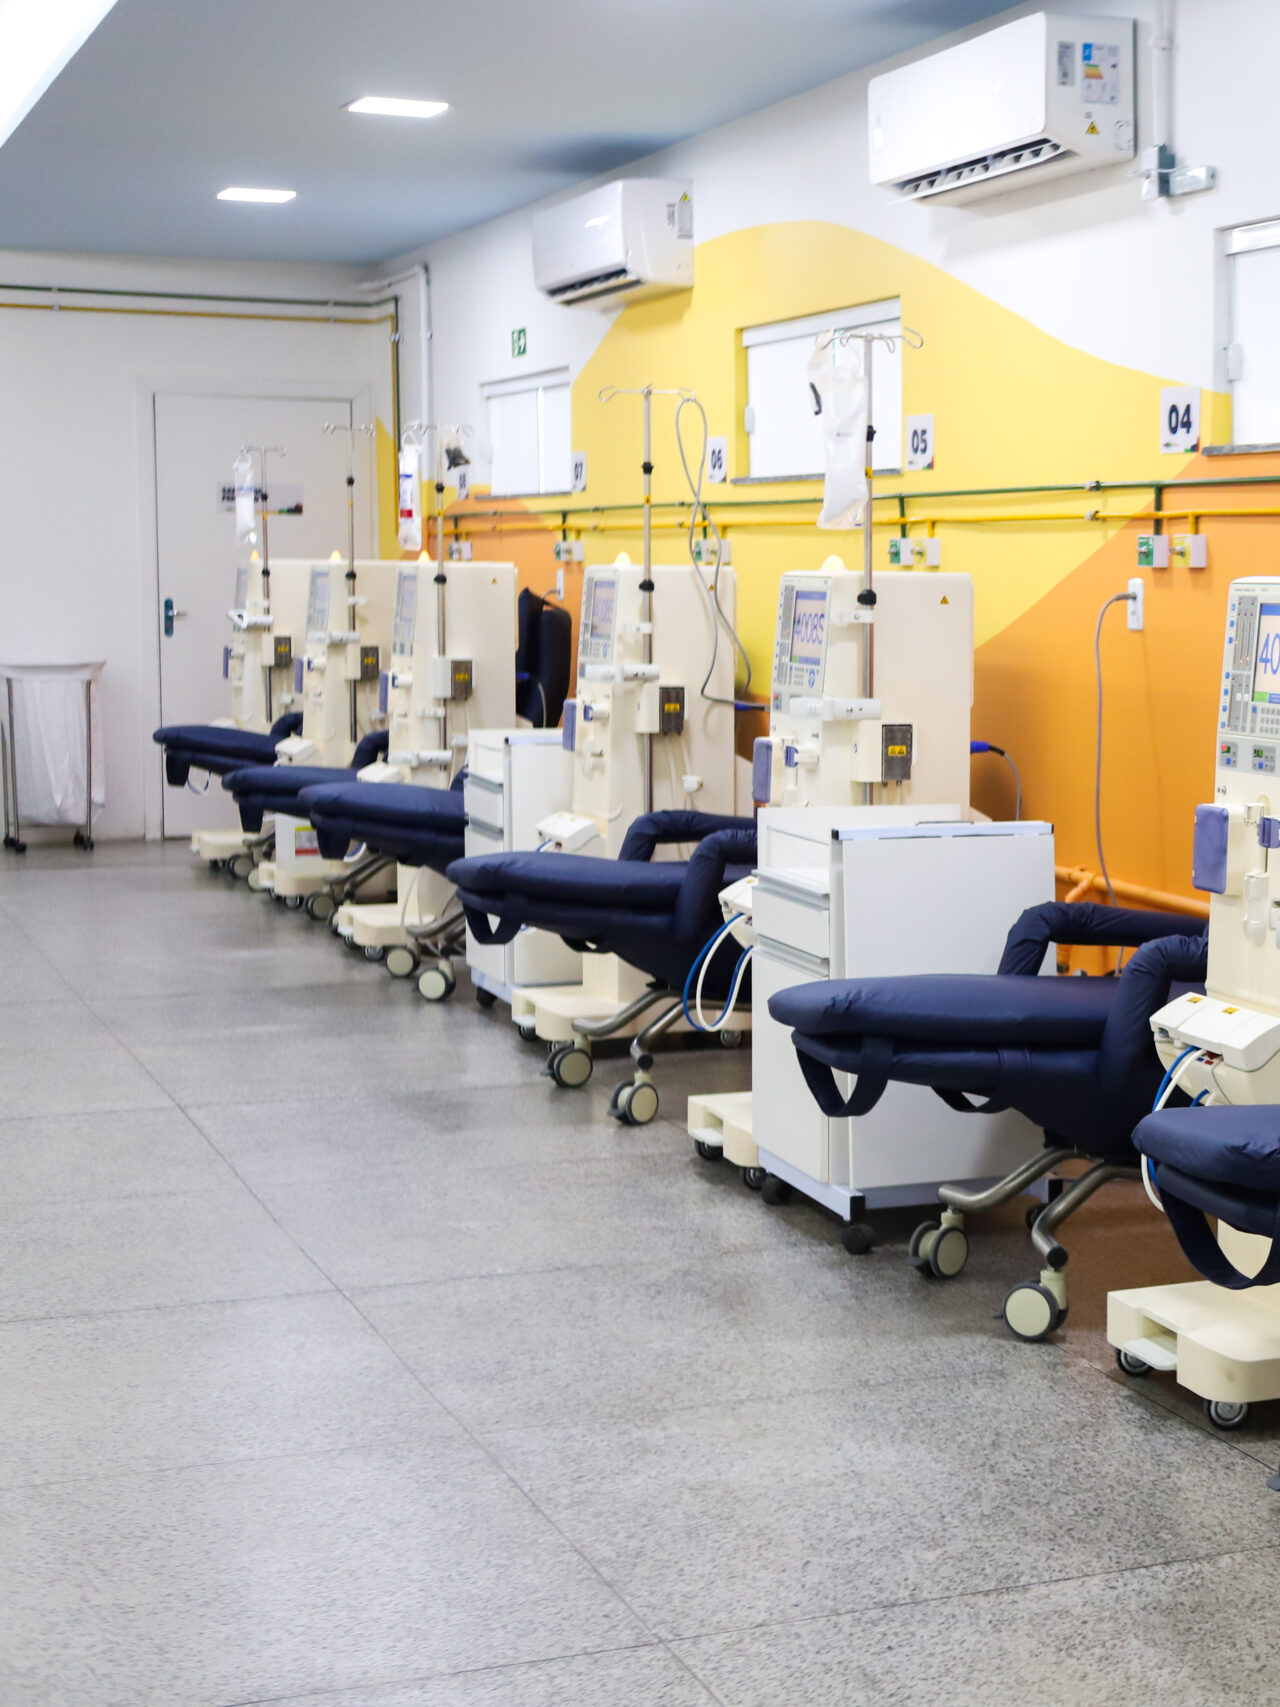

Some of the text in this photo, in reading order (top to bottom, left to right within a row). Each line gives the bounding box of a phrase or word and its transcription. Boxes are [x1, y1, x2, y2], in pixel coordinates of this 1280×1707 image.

[1168, 403, 1192, 435] 04
[911, 428, 928, 455] 05
[574, 461, 583, 481] 07
[711, 449, 723, 470] 06
